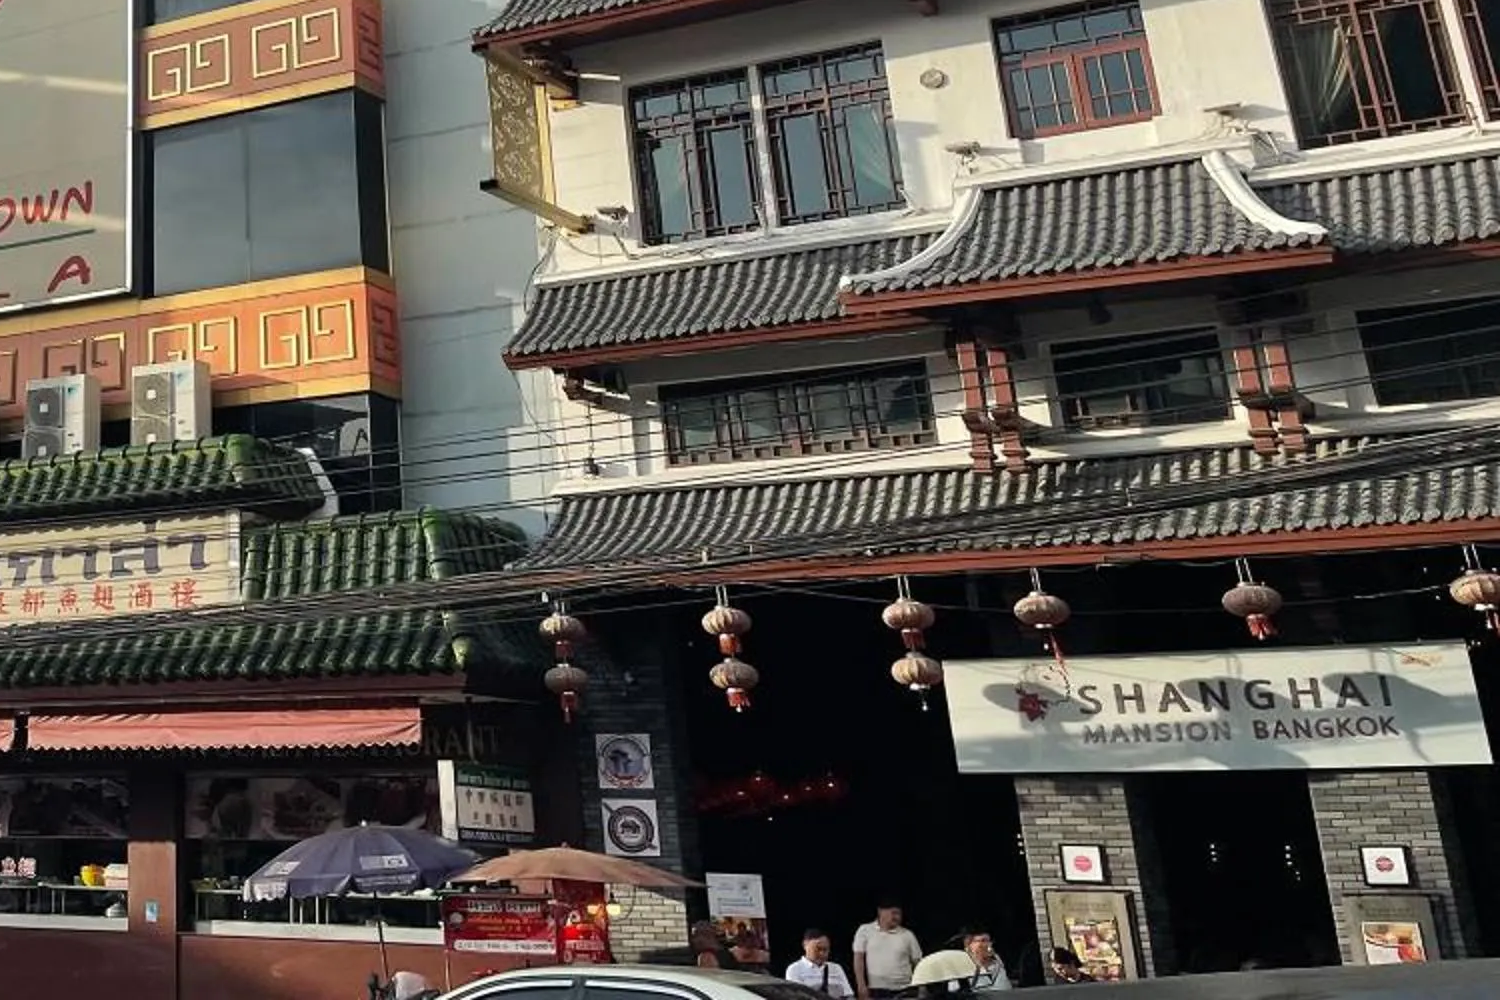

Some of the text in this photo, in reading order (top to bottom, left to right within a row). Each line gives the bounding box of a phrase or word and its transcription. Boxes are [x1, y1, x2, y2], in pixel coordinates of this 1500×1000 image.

[1078, 674, 1393, 715] SHANGHAI
[1083, 715, 1400, 745] MANSION BANGKOK
